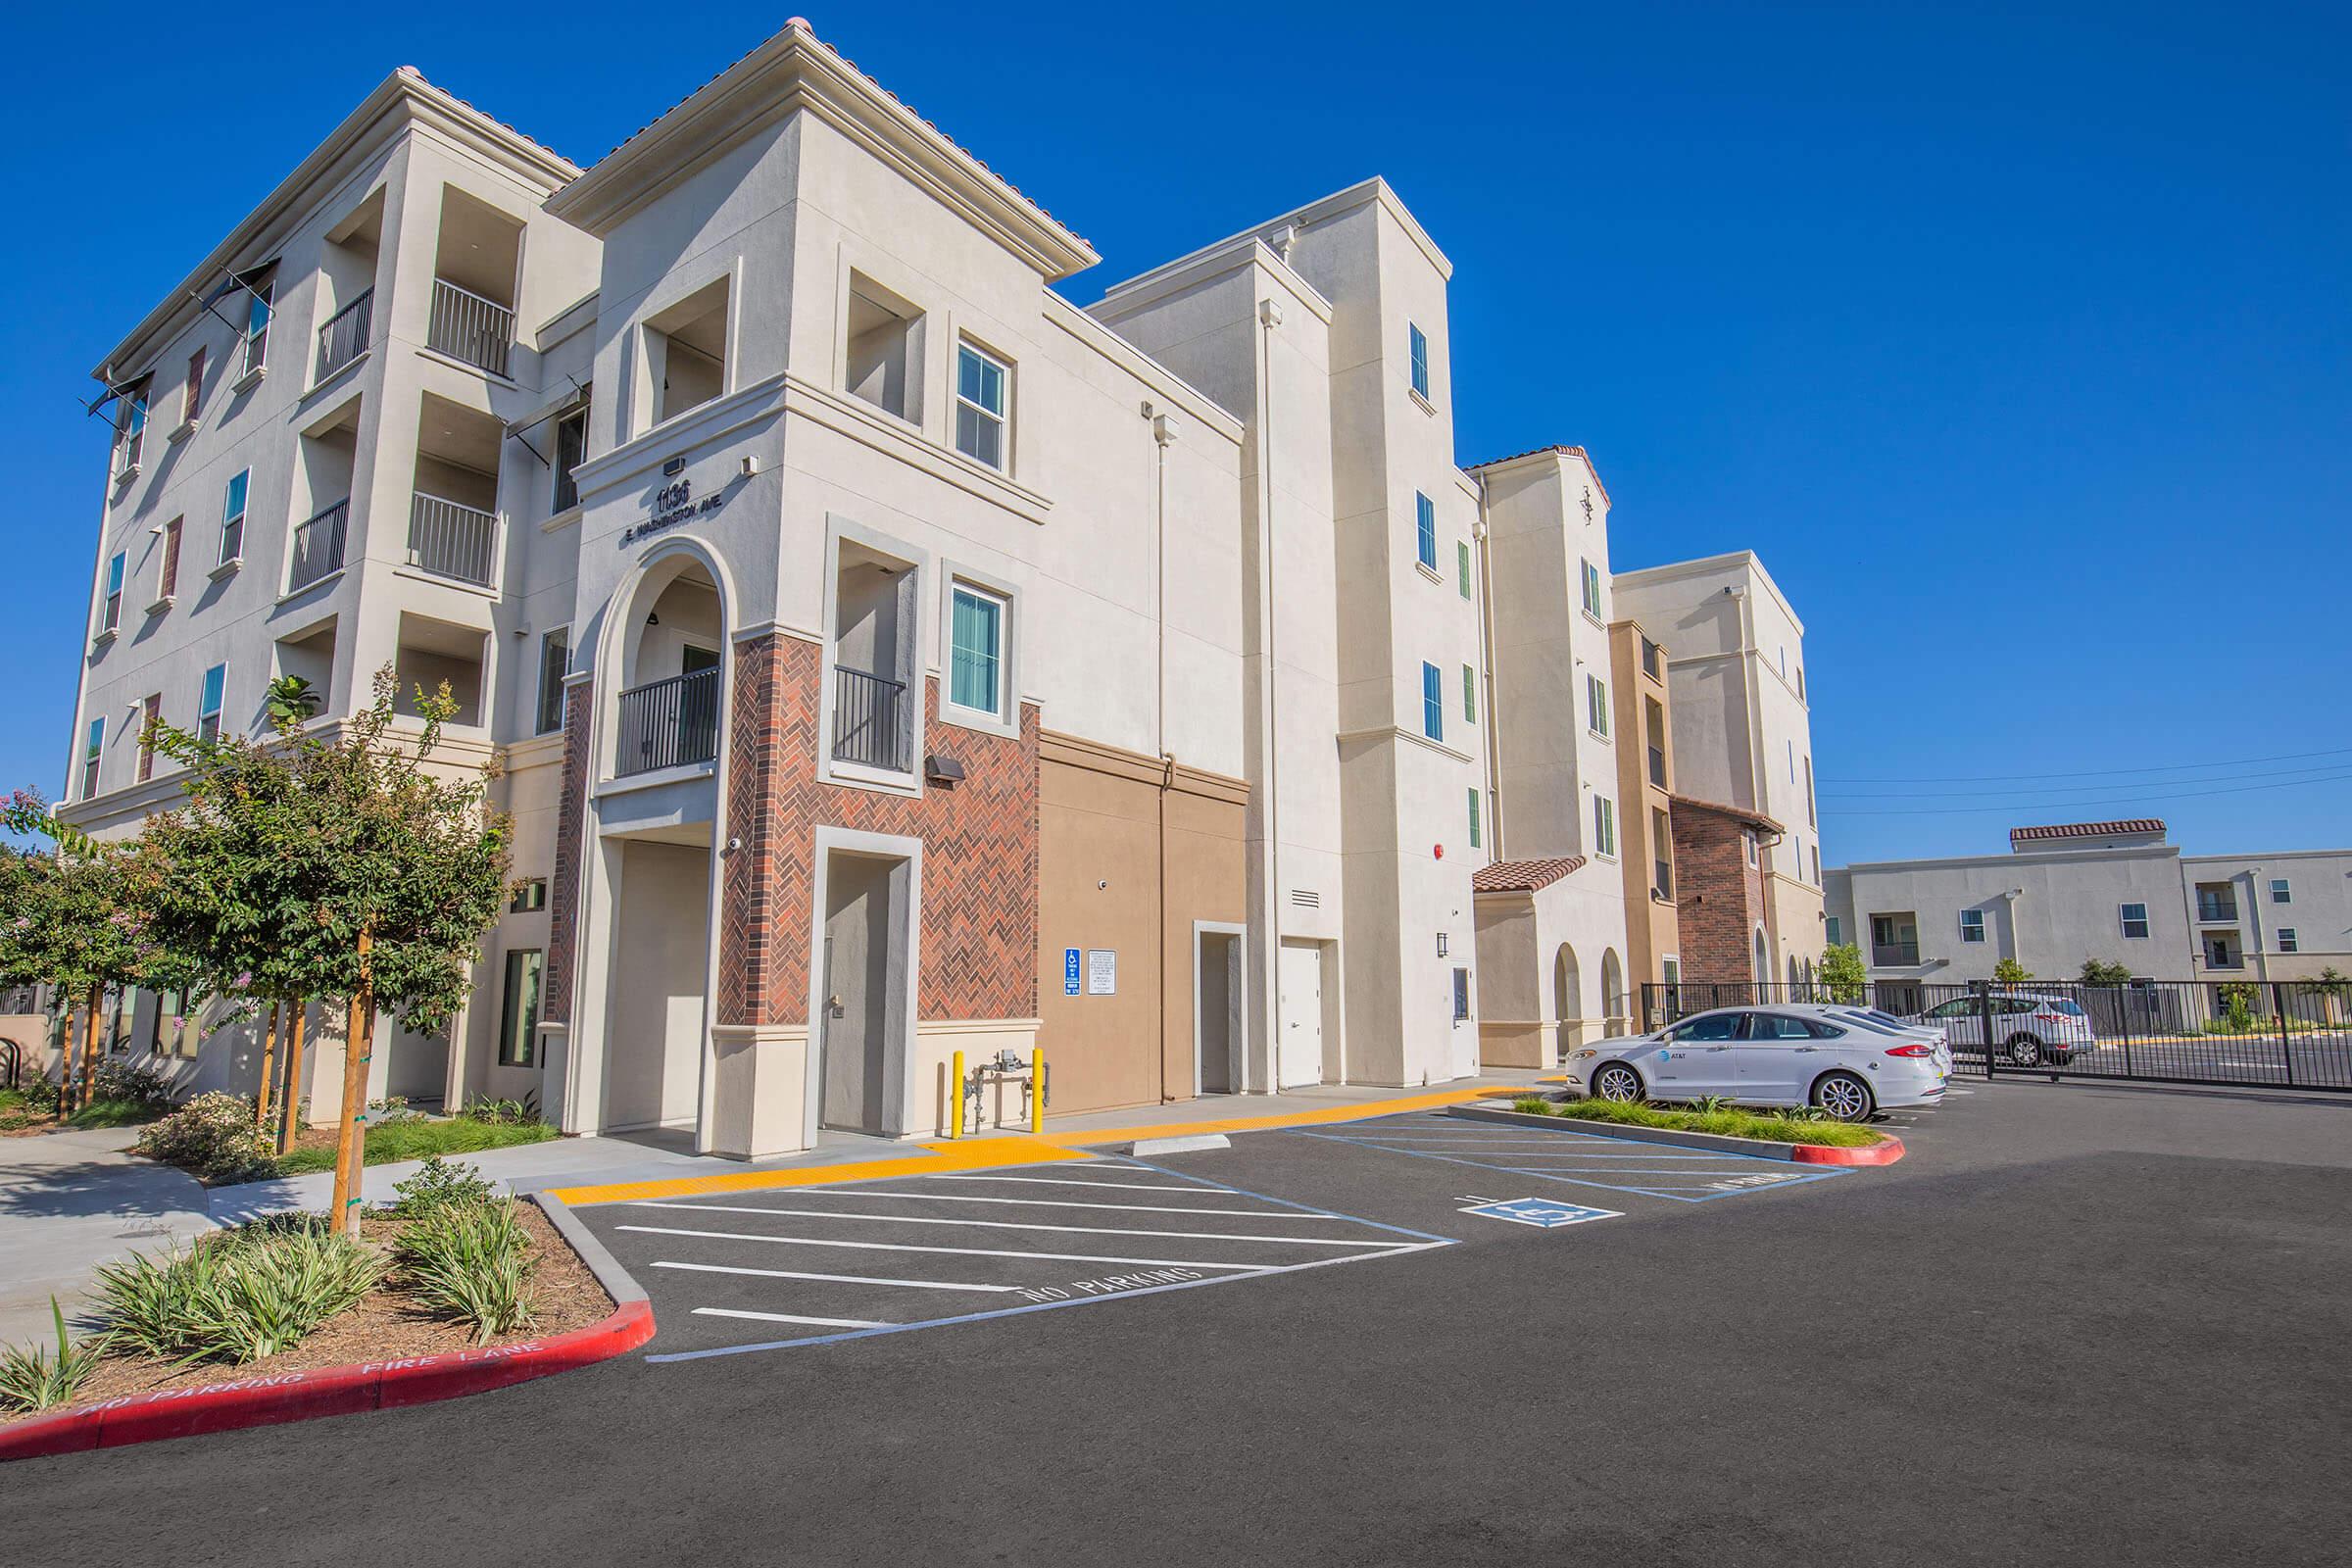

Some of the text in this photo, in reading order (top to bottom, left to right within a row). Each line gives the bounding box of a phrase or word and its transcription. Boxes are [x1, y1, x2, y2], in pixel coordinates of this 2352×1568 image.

[657, 479, 691, 512] 1136
[637, 504, 698, 536] WASHINGTON
[1015, 1268, 1201, 1302] NO PARKING
[362, 1342, 545, 1375] FIRE LANE
[76, 1373, 306, 1416] NO PARKING
